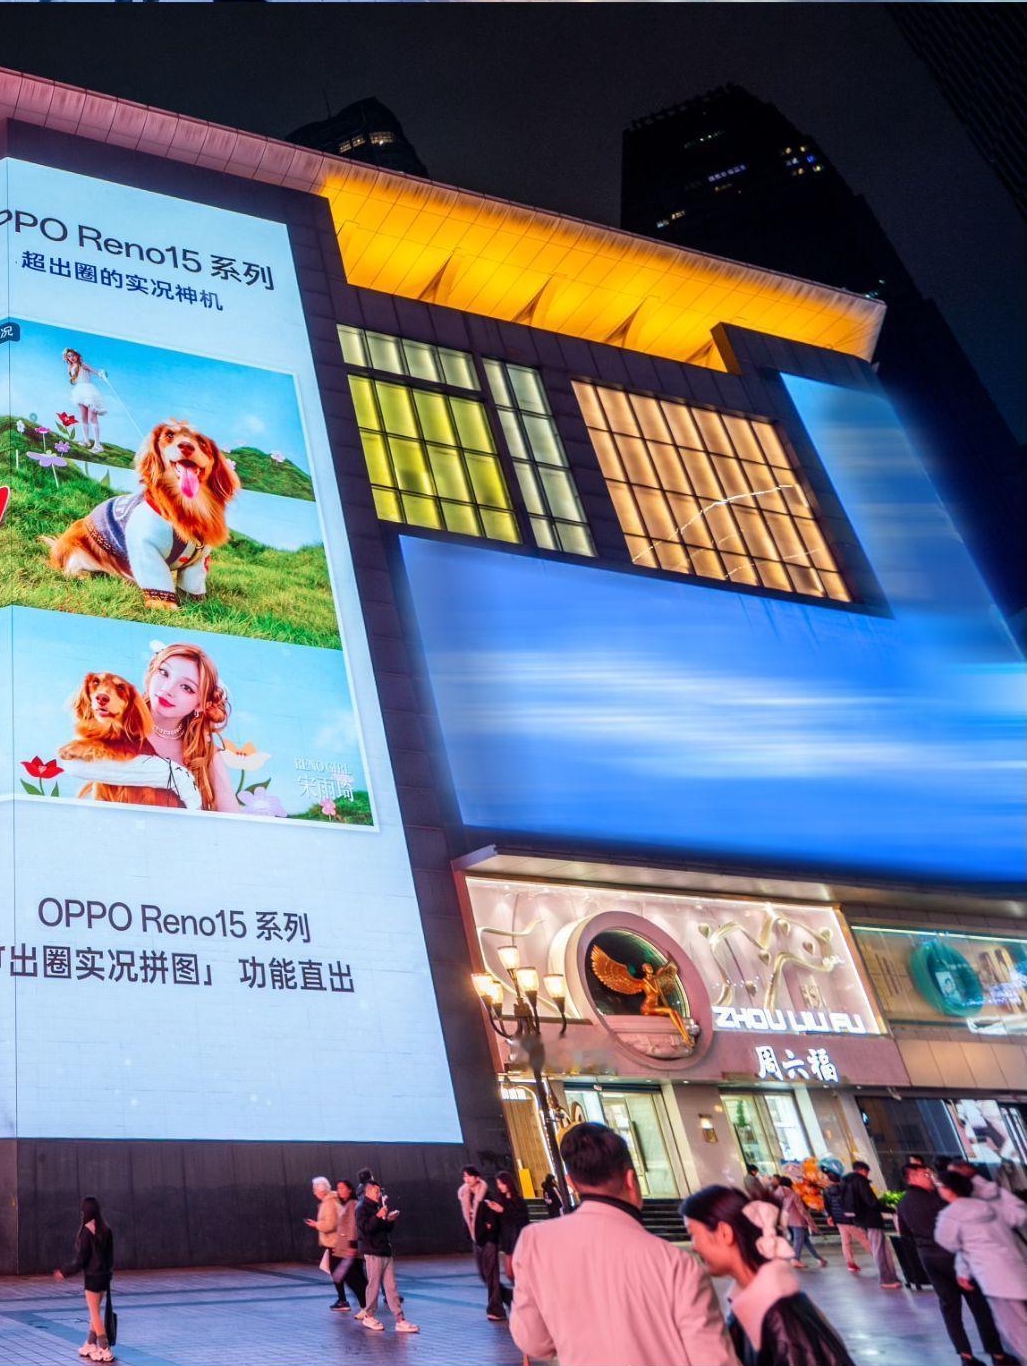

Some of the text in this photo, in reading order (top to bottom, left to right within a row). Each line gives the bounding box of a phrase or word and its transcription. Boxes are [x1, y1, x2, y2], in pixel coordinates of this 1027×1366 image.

[78, 224, 202, 273] Reno15
[210, 254, 275, 291] 系列
[21, 250, 224, 311] 超出圈的实况神机
[38, 897, 312, 944] OPPO Reno15 系列
[238, 956, 356, 993] 功能直出
[711, 1006, 867, 1034] ZHOU LIU FU
[755, 1045, 839, 1083] 周六福
